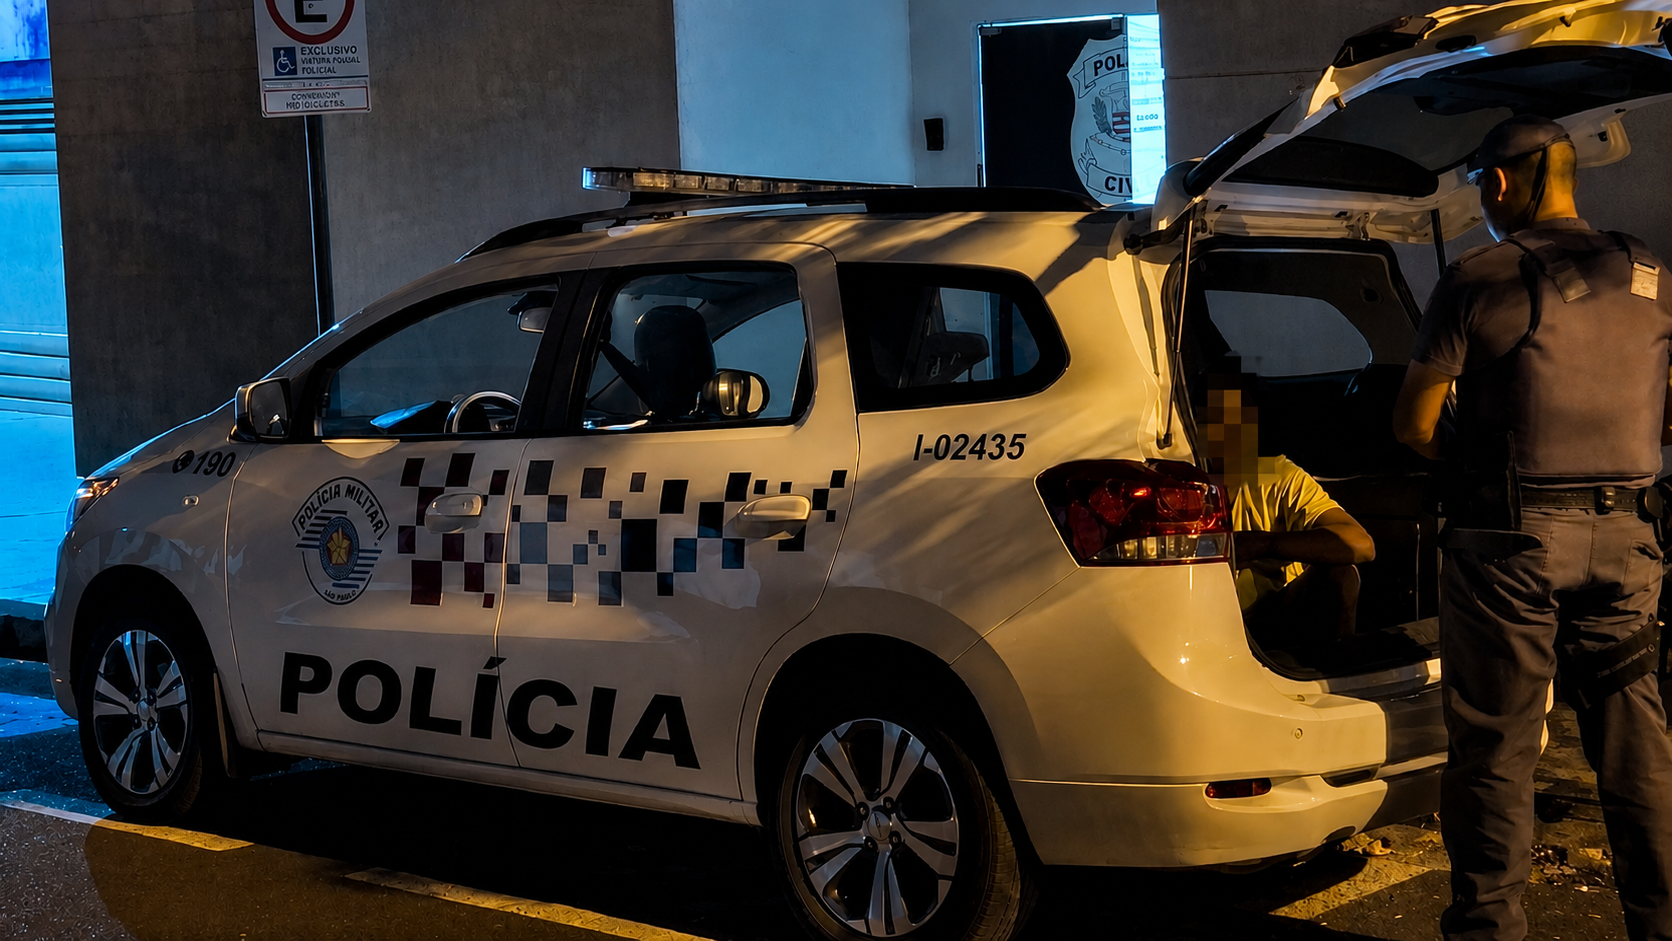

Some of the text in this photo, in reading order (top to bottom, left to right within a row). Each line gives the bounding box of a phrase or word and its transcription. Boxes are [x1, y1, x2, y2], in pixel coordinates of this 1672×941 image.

[300, 46, 358, 56] EXCLUSIVO
[1093, 54, 1128, 77] POL
[913, 433, 1027, 461] I-02435
[192, 450, 236, 477] 190
[297, 483, 384, 534] POLÍCIA MILITAR
[280, 651, 701, 769] POLÍCIA
